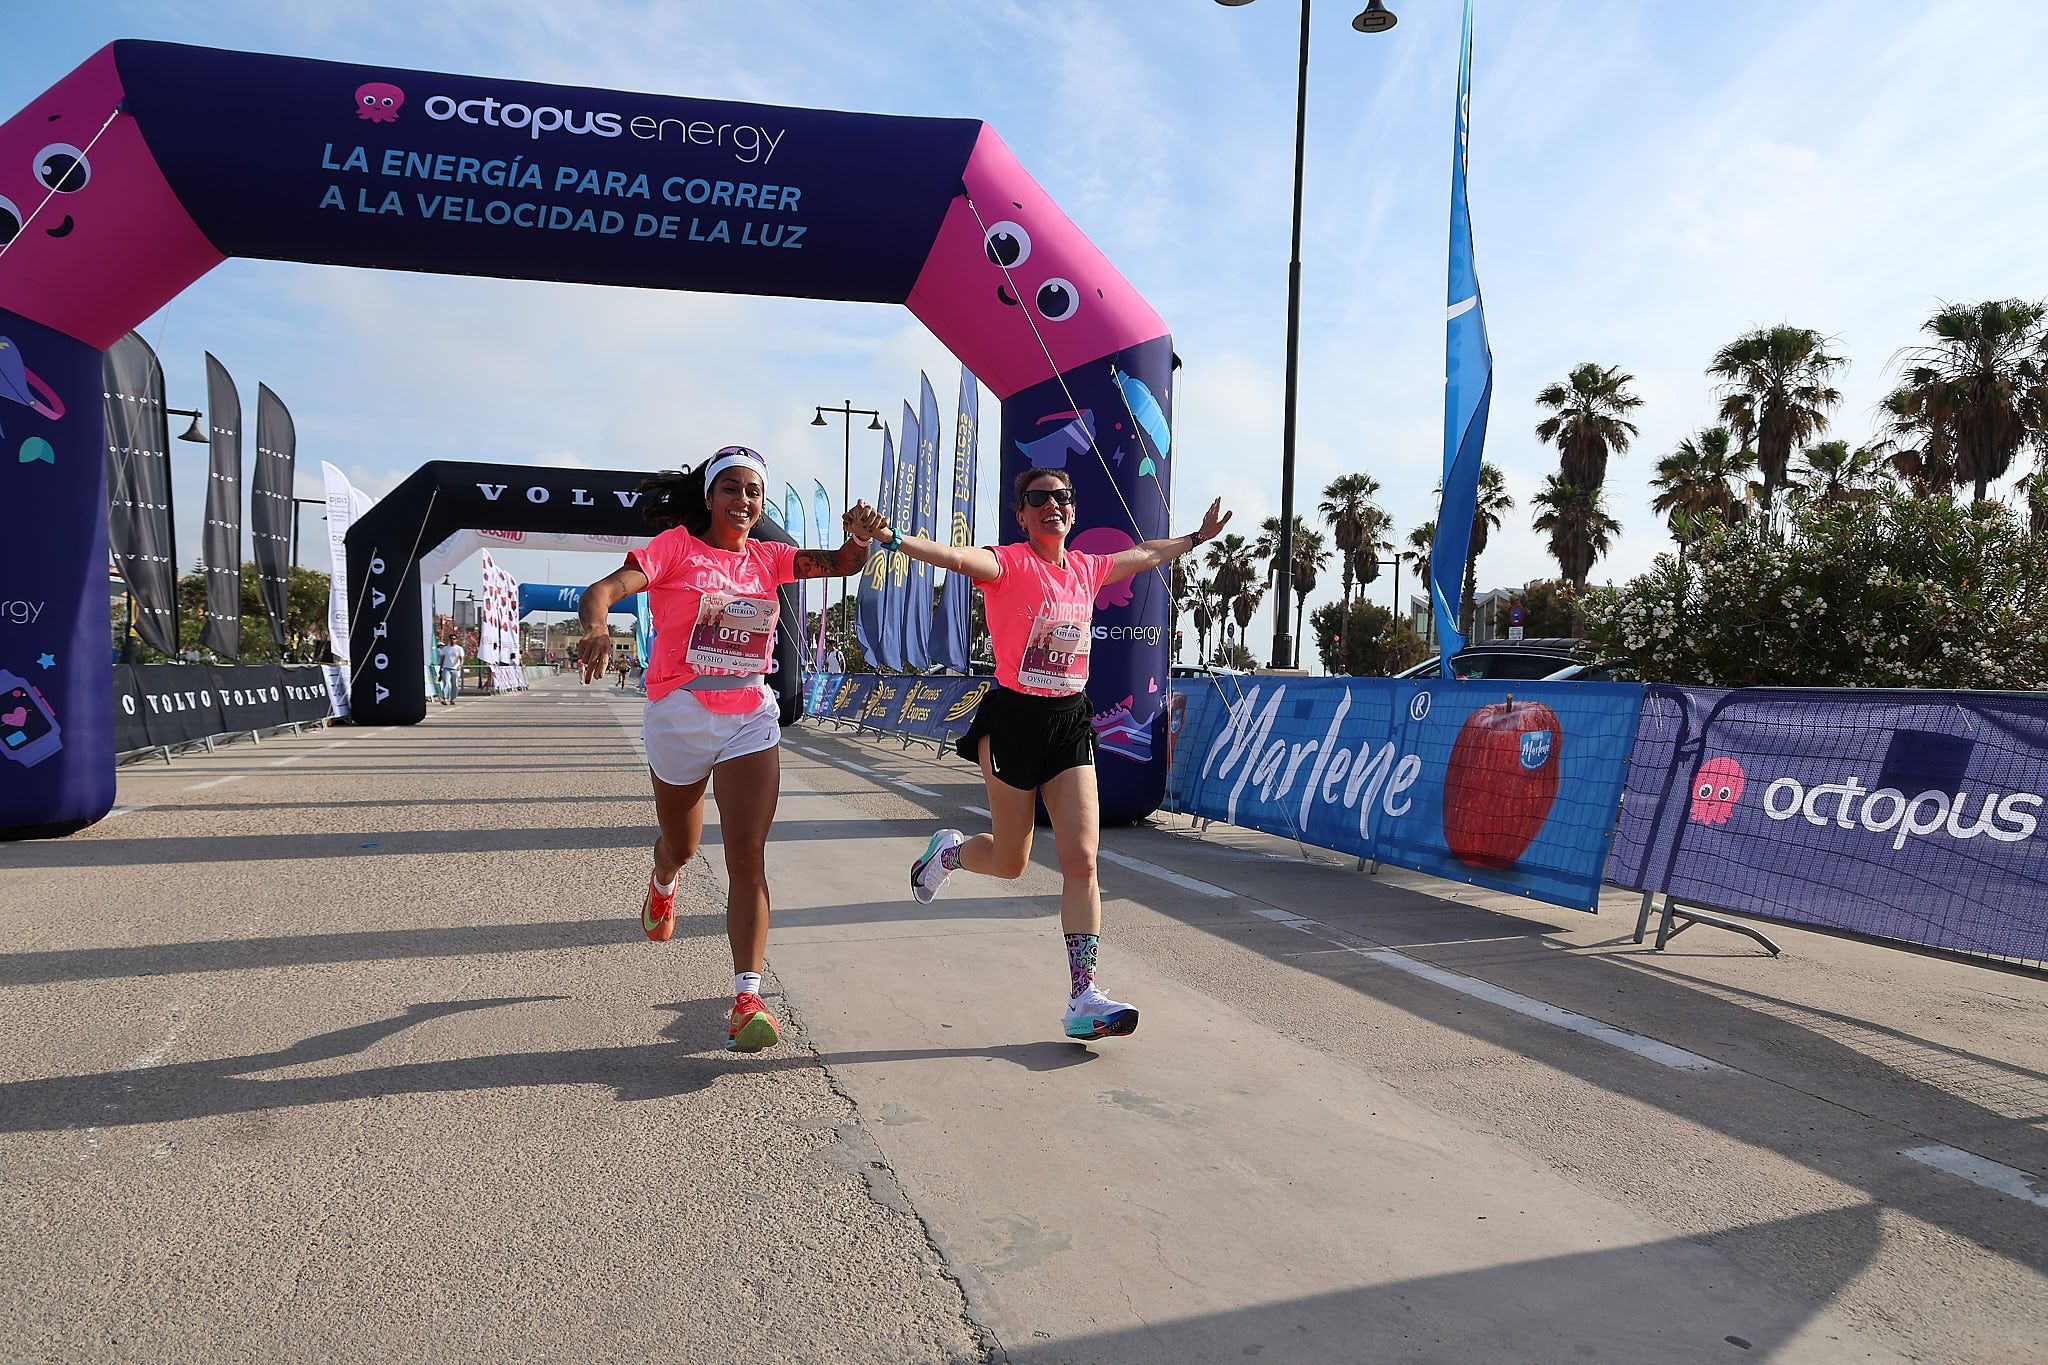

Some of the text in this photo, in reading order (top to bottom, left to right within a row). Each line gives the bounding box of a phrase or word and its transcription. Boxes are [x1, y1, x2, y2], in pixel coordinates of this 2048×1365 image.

[424, 95, 785, 165] octopus energy
[321, 143, 802, 212] LA ENERGÍA PARA CORRER
[319, 185, 807, 249] A LA VELOCIDAD DE LA LUZ
[371, 557, 391, 704] VOLVO
[719, 627, 751, 643] 016
[1110, 626, 1162, 646] energy
[696, 653, 723, 664] OYSHO
[1027, 675, 1052, 685] OYSHO
[1048, 651, 1075, 665] 016
[146, 689, 212, 714] VOLVO
[219, 685, 279, 706] VOLVO
[1203, 685, 1422, 840] Marlene
[1763, 776, 2044, 850] octopus
